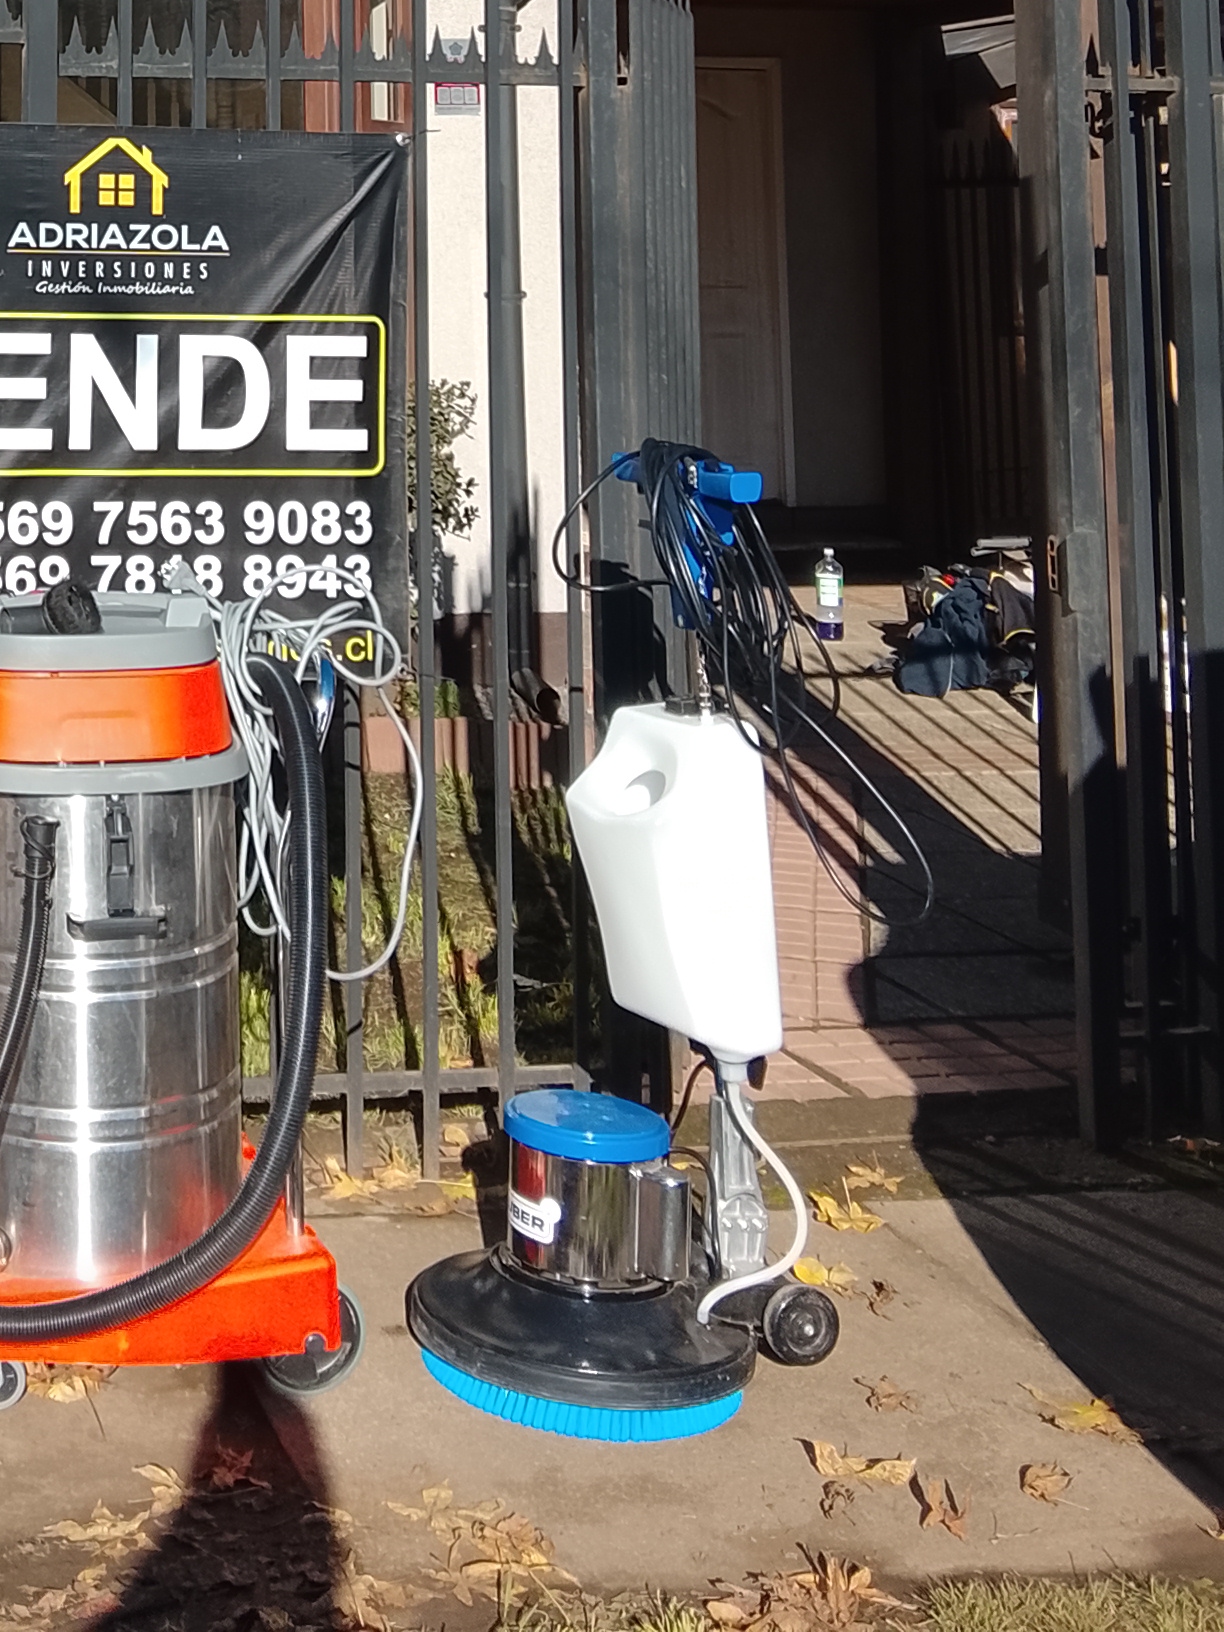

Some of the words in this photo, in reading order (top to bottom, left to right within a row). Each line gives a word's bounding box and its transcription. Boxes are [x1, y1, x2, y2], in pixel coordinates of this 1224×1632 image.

[7, 221, 230, 251] ADRIAZOLA
[26, 259, 209, 280] INVERSIONES
[34, 280, 94, 294] Gestión
[97, 282, 195, 295] Inmobiliaria
[92, 500, 226, 546] 7563
[242, 500, 373, 546] 9083
[90, 554, 224, 598] 788
[242, 554, 373, 599] 8943
